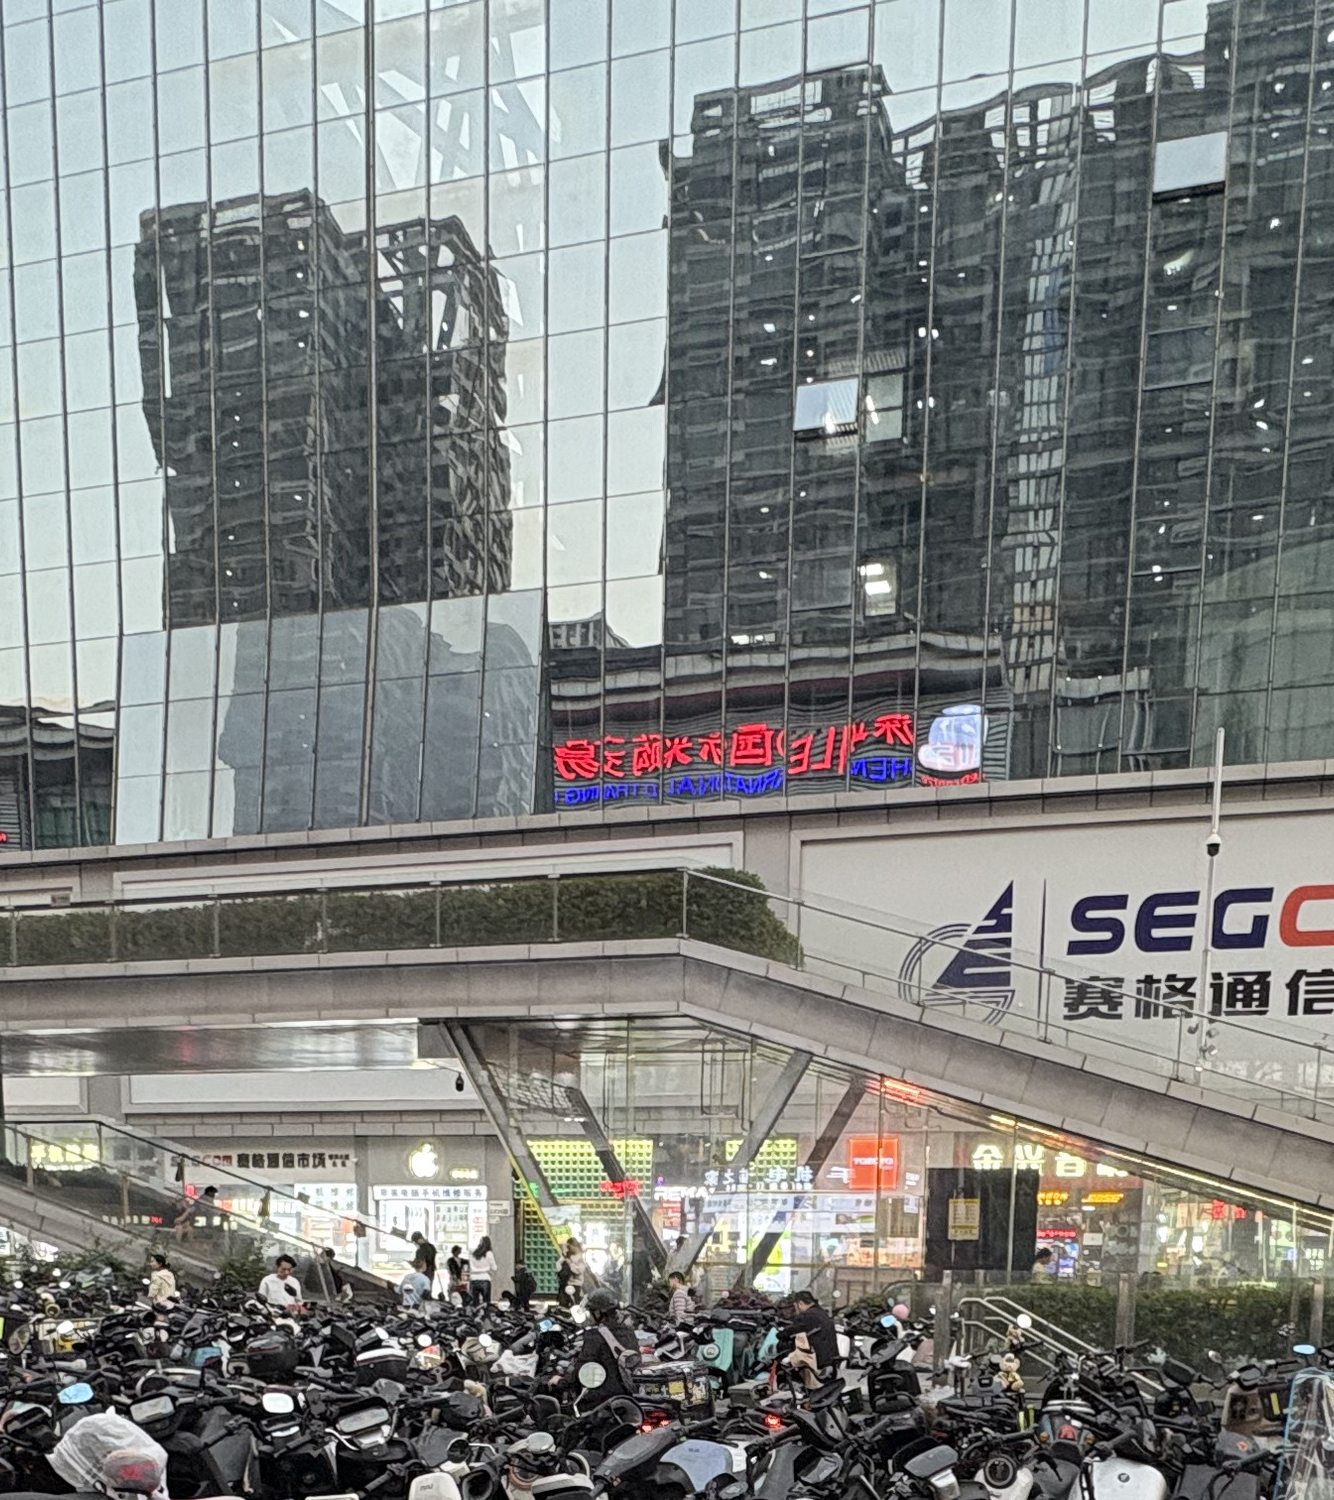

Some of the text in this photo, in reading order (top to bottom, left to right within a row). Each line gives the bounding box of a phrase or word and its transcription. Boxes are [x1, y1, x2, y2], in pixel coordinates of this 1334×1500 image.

[236, 1153, 326, 1168] 赛格通信市场
